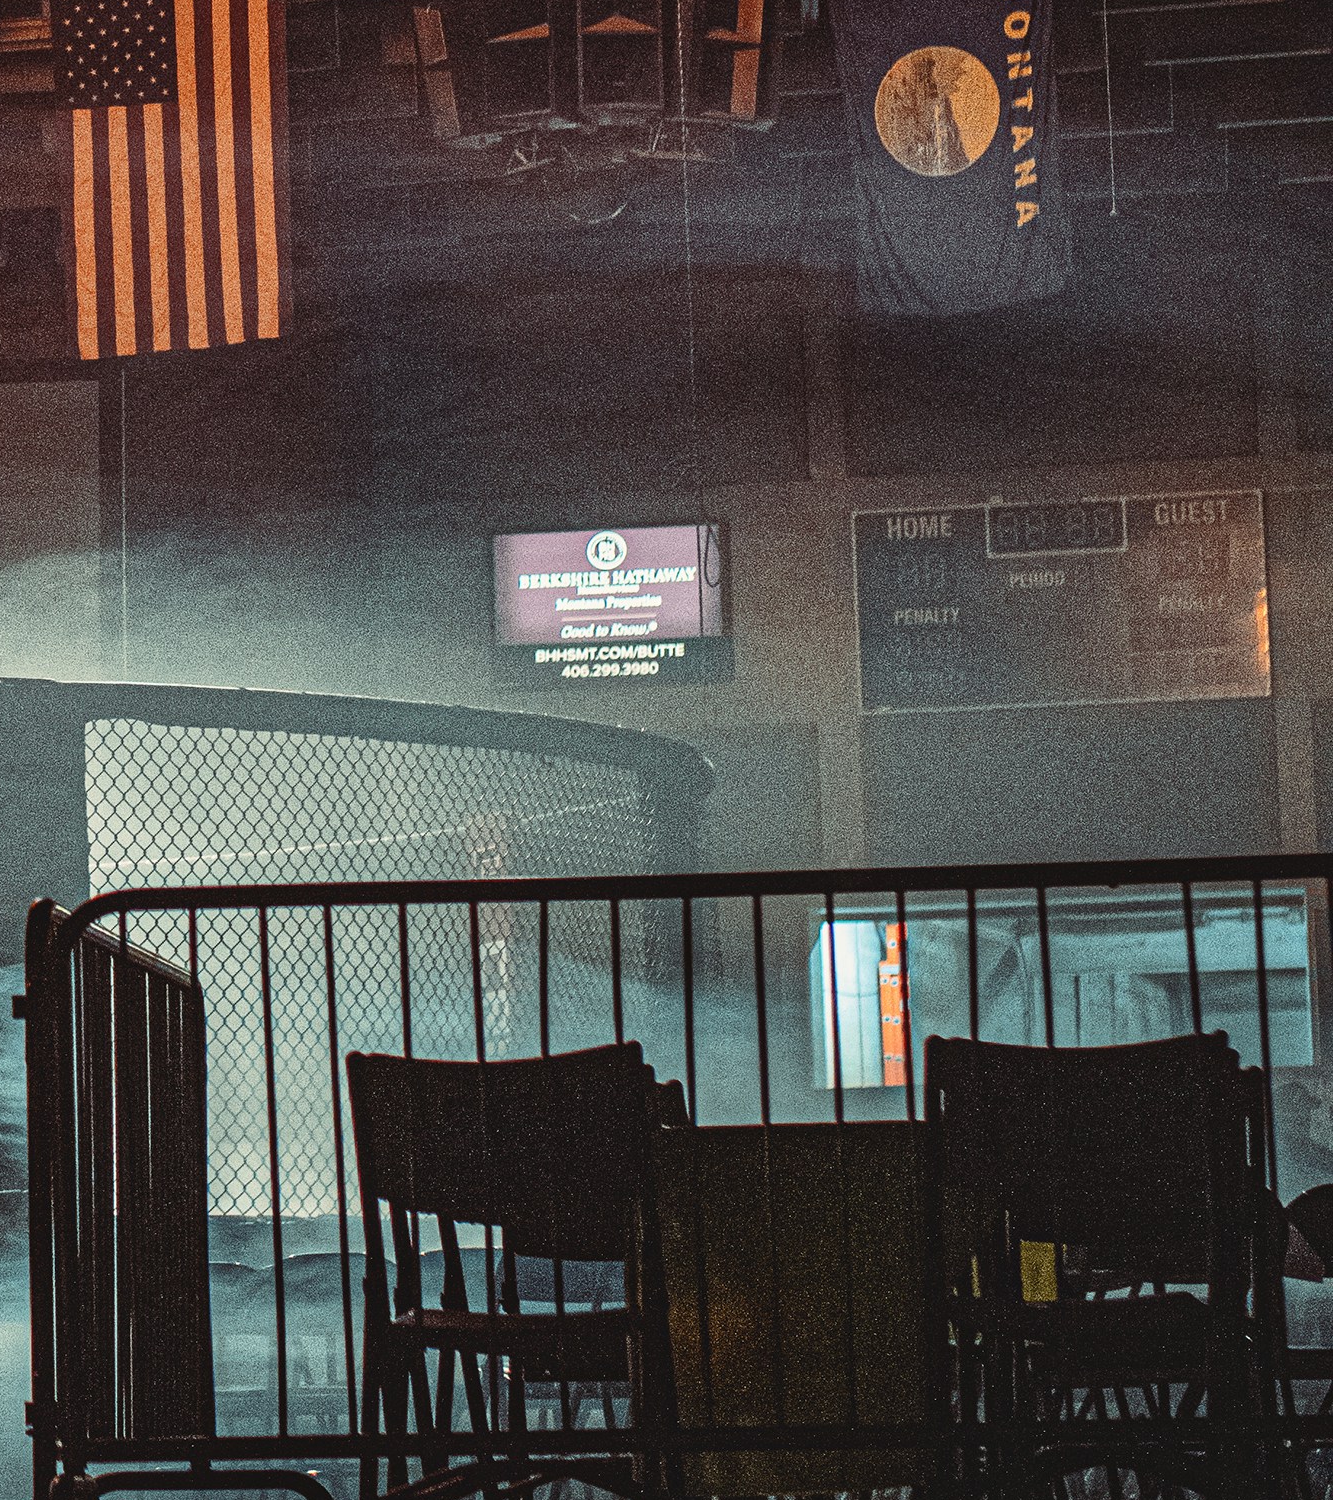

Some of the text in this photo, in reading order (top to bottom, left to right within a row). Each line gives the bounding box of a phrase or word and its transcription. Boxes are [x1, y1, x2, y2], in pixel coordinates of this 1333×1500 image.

[1153, 499, 1229, 526] GUEST
[887, 515, 953, 541] HOME
[519, 566, 697, 589] BERKSHIRE HATHAWAY
[893, 607, 960, 626] PENALTY
[535, 643, 685, 663] BHHSMT.COM/BUTTE
